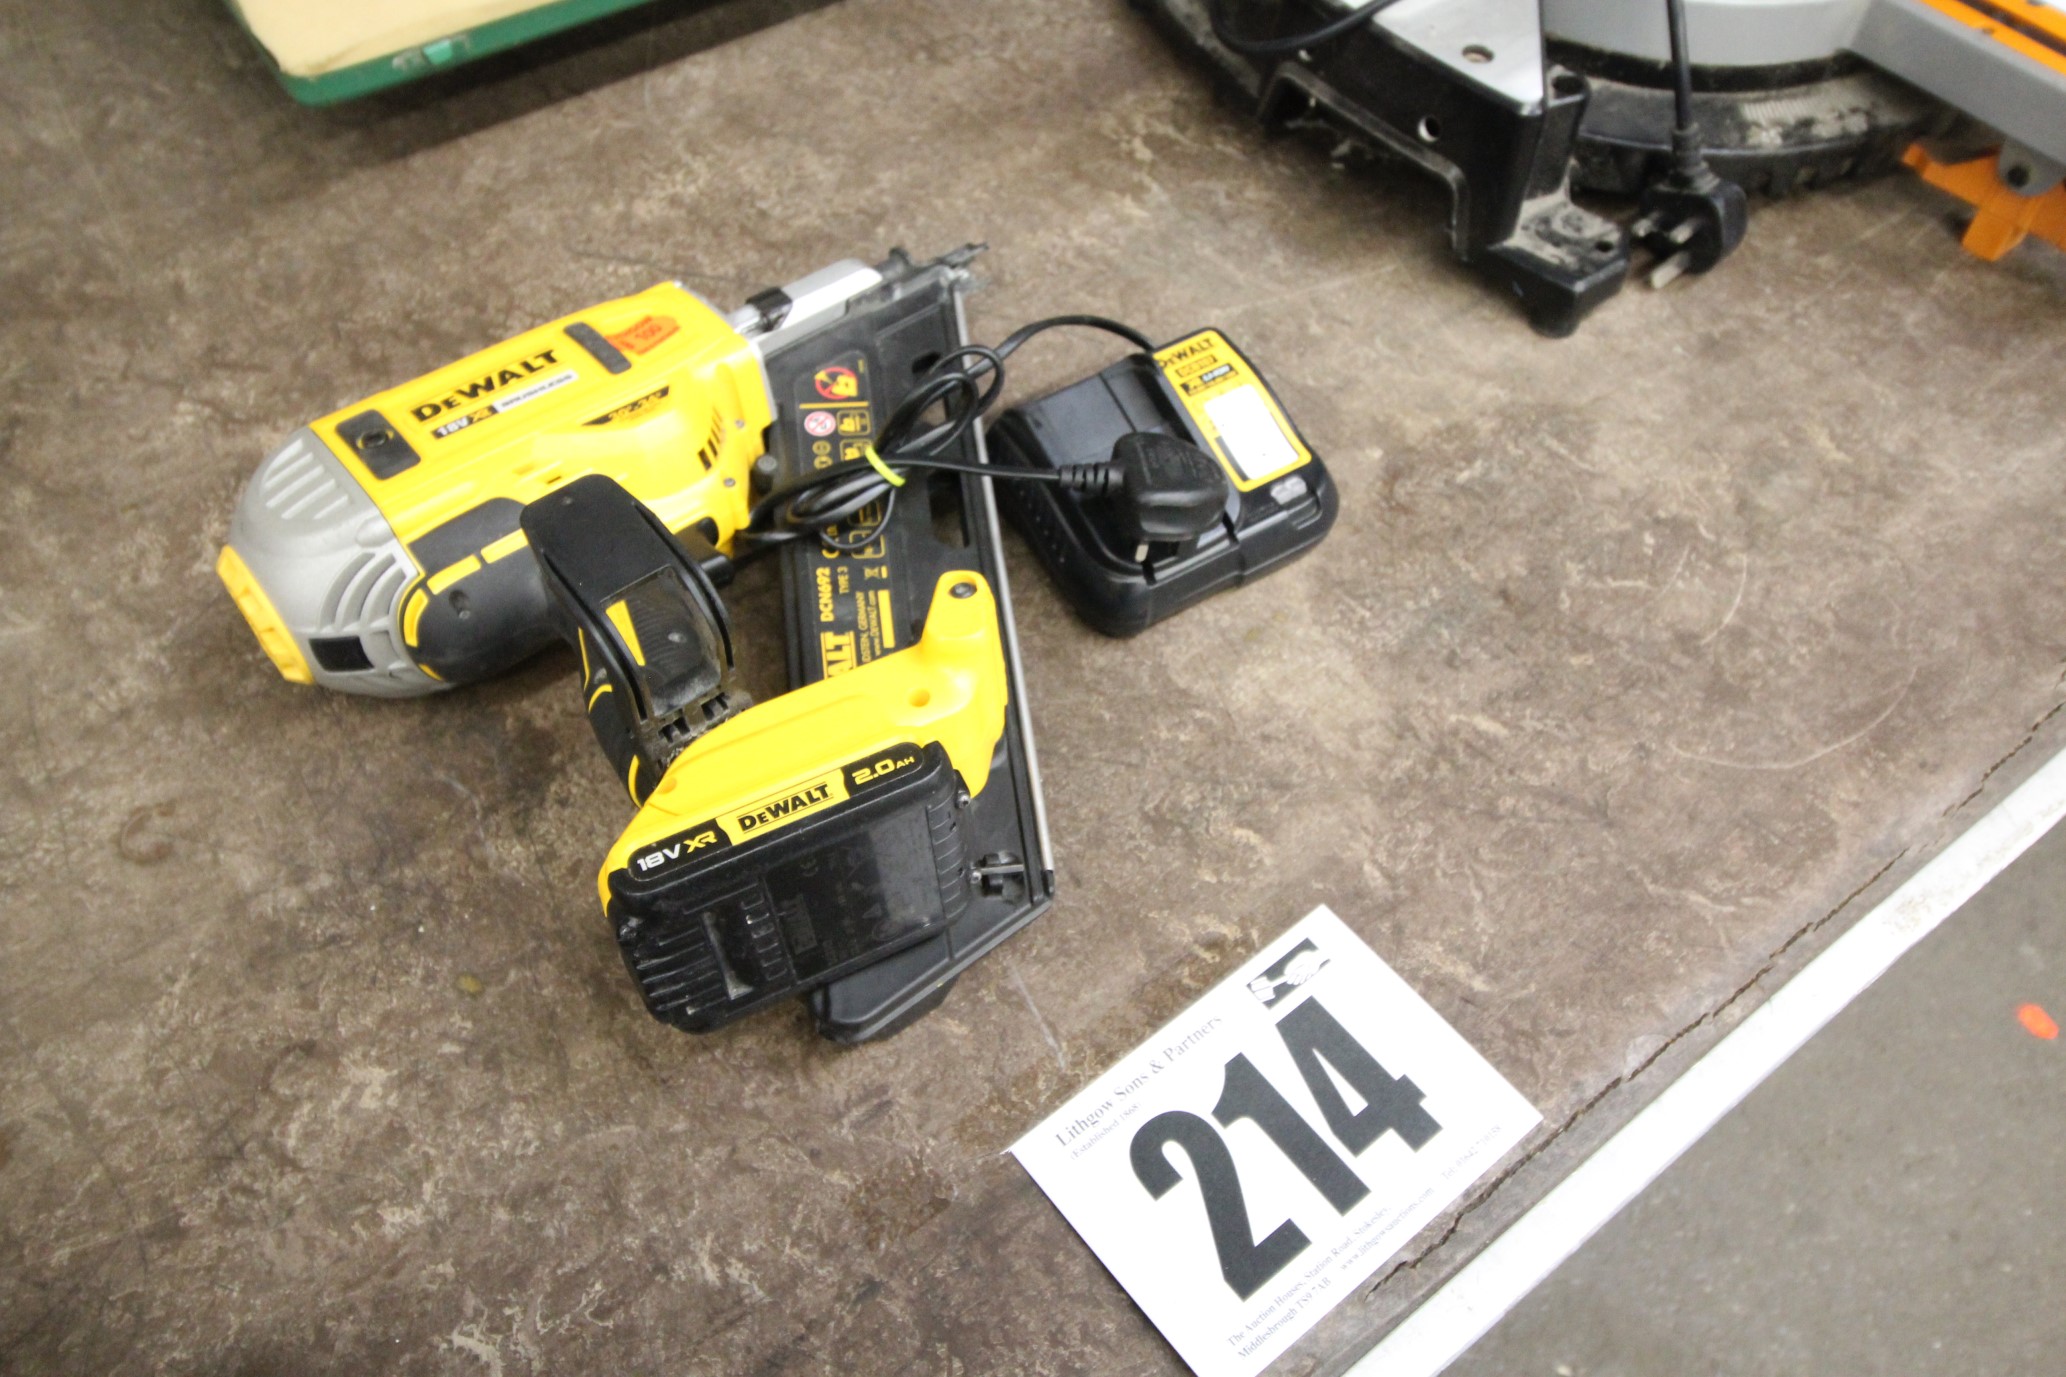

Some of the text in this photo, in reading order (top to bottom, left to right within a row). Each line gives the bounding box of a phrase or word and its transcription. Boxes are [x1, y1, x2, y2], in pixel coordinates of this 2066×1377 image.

[410, 348, 560, 424] DEWALT
[434, 414, 468, 440] 18V
[816, 567, 835, 622] DCN692
[837, 566, 850, 594] TYPE 3
[856, 591, 869, 631] GERMANY
[636, 841, 683, 873] 18V
[681, 829, 719, 852] XR
[737, 782, 831, 832] DEWALT
[1055, 1016, 1223, 1147] Lithgow Sons & Partners
[1070, 1118, 1120, 1160] (Established
[1128, 994, 1444, 1302] 214
[1226, 1328, 1247, 1347] The
[1243, 1304, 1277, 1332] Auction
[1304, 1254, 1333, 1281] Station
[1237, 1307, 1299, 1359] Middlesbrough
